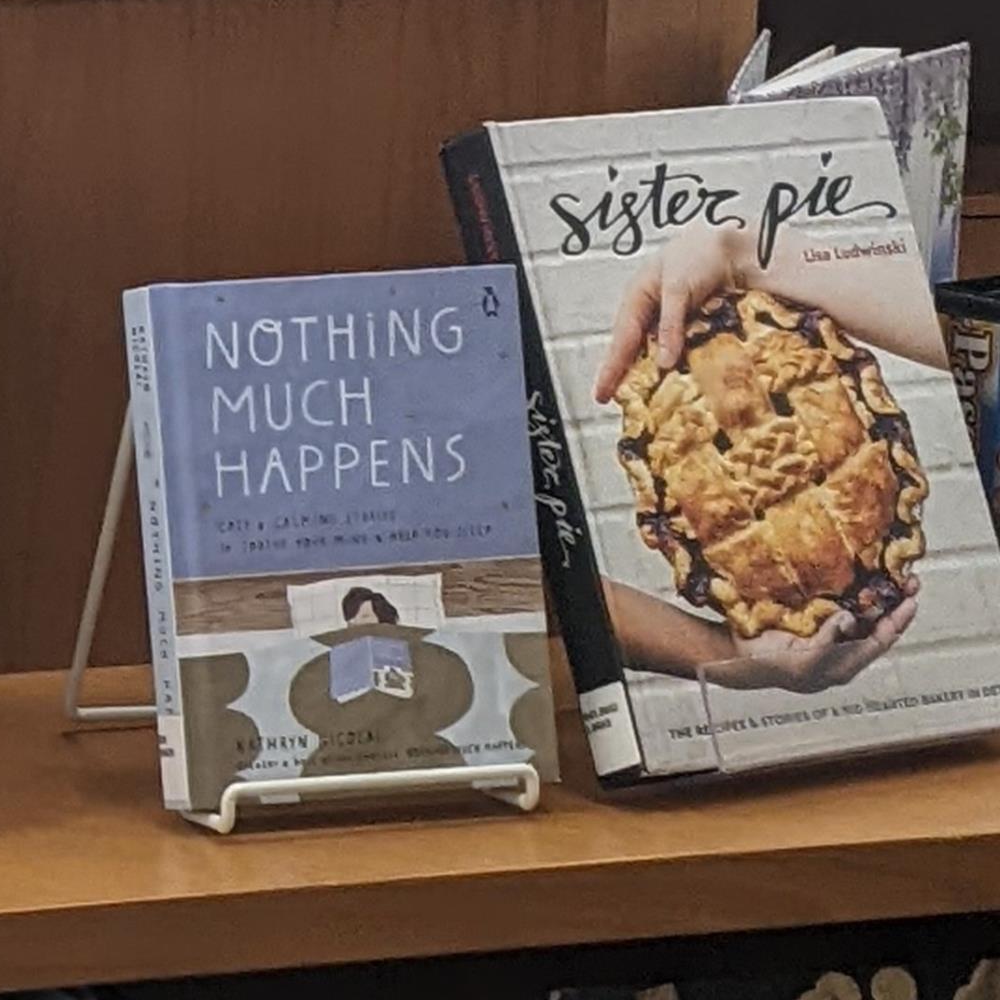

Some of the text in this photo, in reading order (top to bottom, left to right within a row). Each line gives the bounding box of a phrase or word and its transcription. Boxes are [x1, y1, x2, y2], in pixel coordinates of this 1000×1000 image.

[549, 163, 745, 257] sister
[757, 150, 897, 270] pie
[803, 248, 832, 263] Lisa
[211, 376, 373, 435] MUCH
[213, 433, 466, 498] HAPPENS
[533, 490, 579, 568] pie
